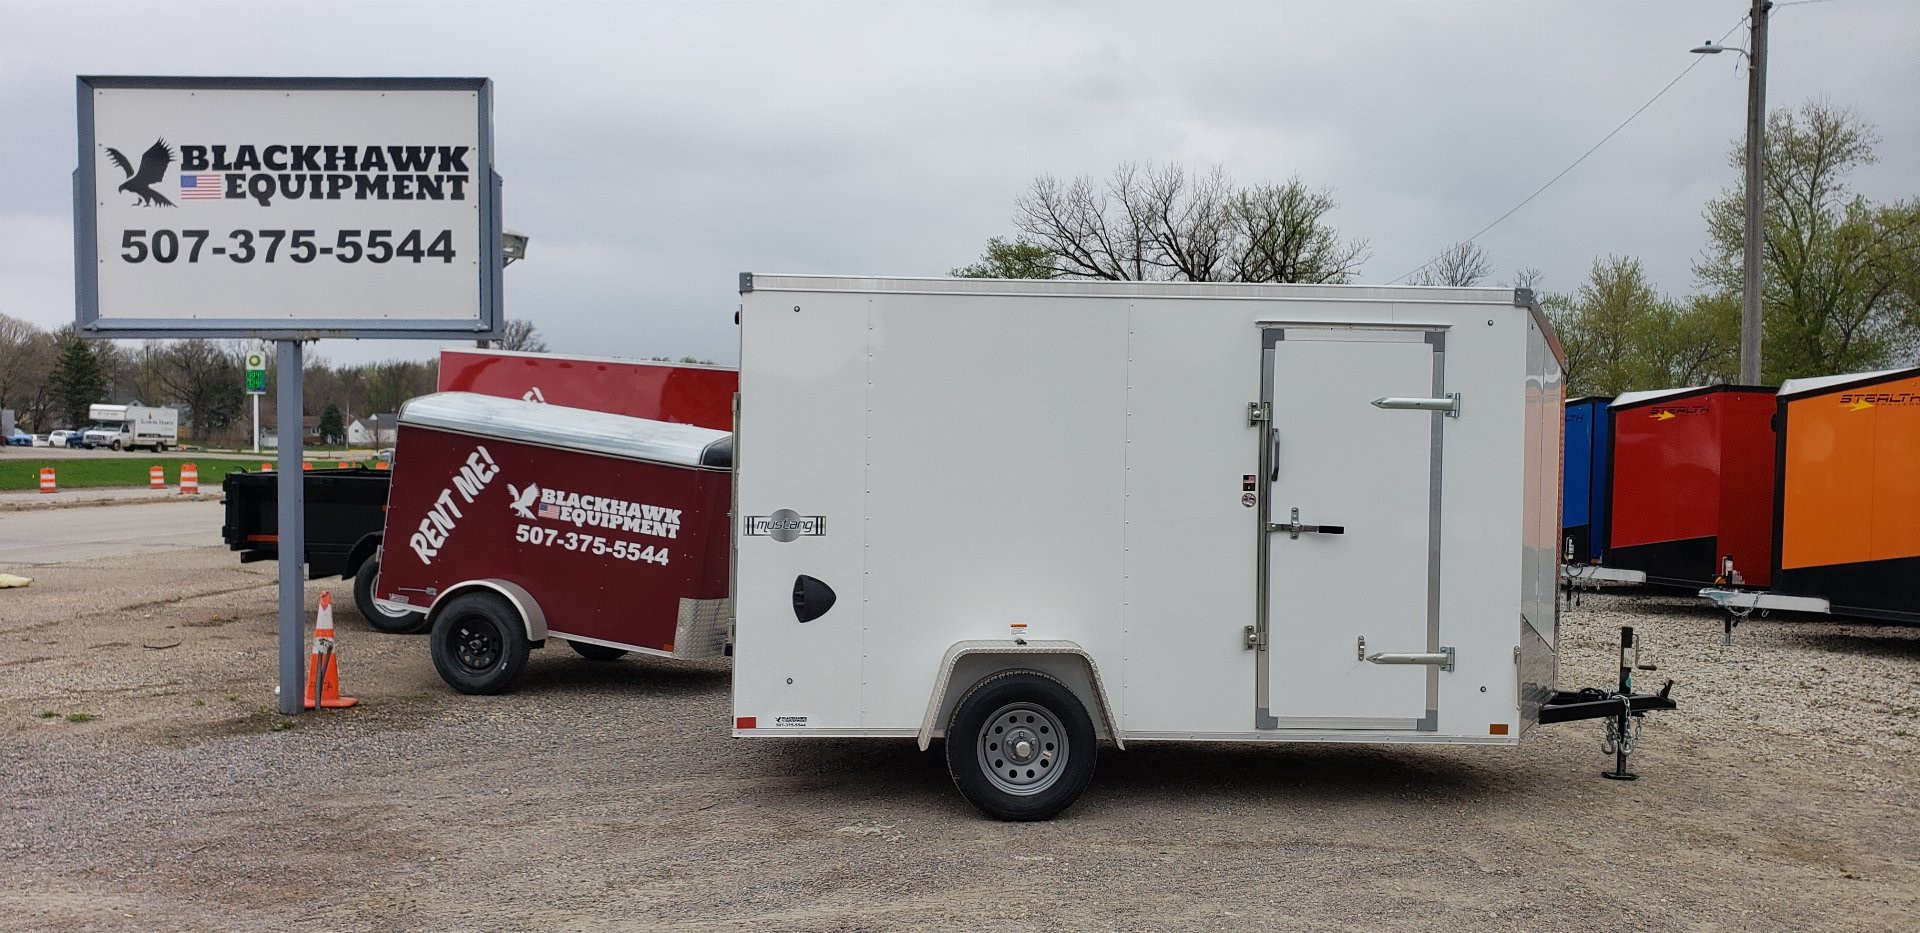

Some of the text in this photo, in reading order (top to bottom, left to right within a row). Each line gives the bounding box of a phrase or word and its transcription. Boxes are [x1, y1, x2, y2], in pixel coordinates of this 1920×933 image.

[180, 144, 470, 172] BLACKHAWK
[224, 173, 469, 206] EQUIPMENT
[120, 229, 456, 264] 507-375-5544
[409, 445, 501, 566] RENT ME!
[540, 488, 682, 525] BLACKHAWK
[560, 507, 680, 539] EQUIPMENT
[756, 518, 814, 533] mustang
[515, 524, 670, 566] 507-375-5544
